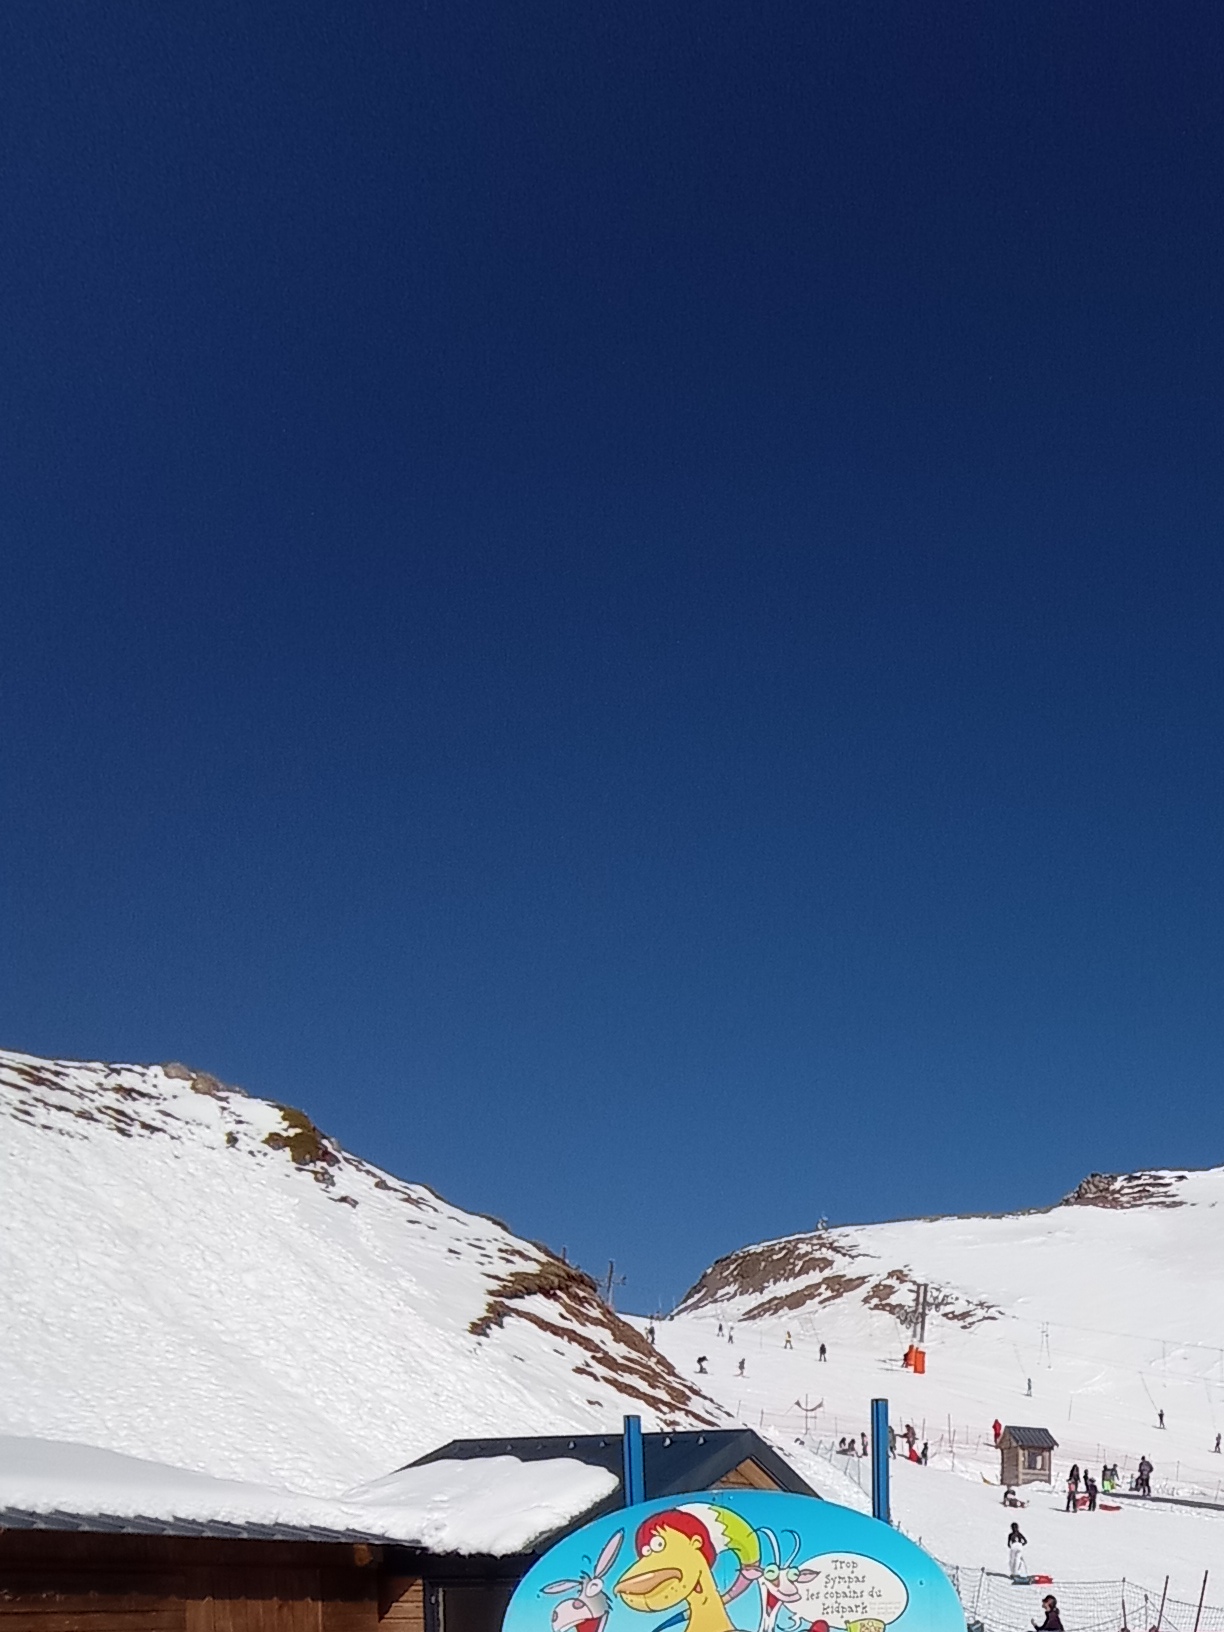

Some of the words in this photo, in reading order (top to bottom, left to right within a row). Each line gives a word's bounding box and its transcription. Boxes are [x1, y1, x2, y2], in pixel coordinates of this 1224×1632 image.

[831, 1559, 858, 1574] Trop
[806, 1588, 820, 1601] les
[823, 1589, 864, 1604] copains
[868, 1586, 882, 1598] du
